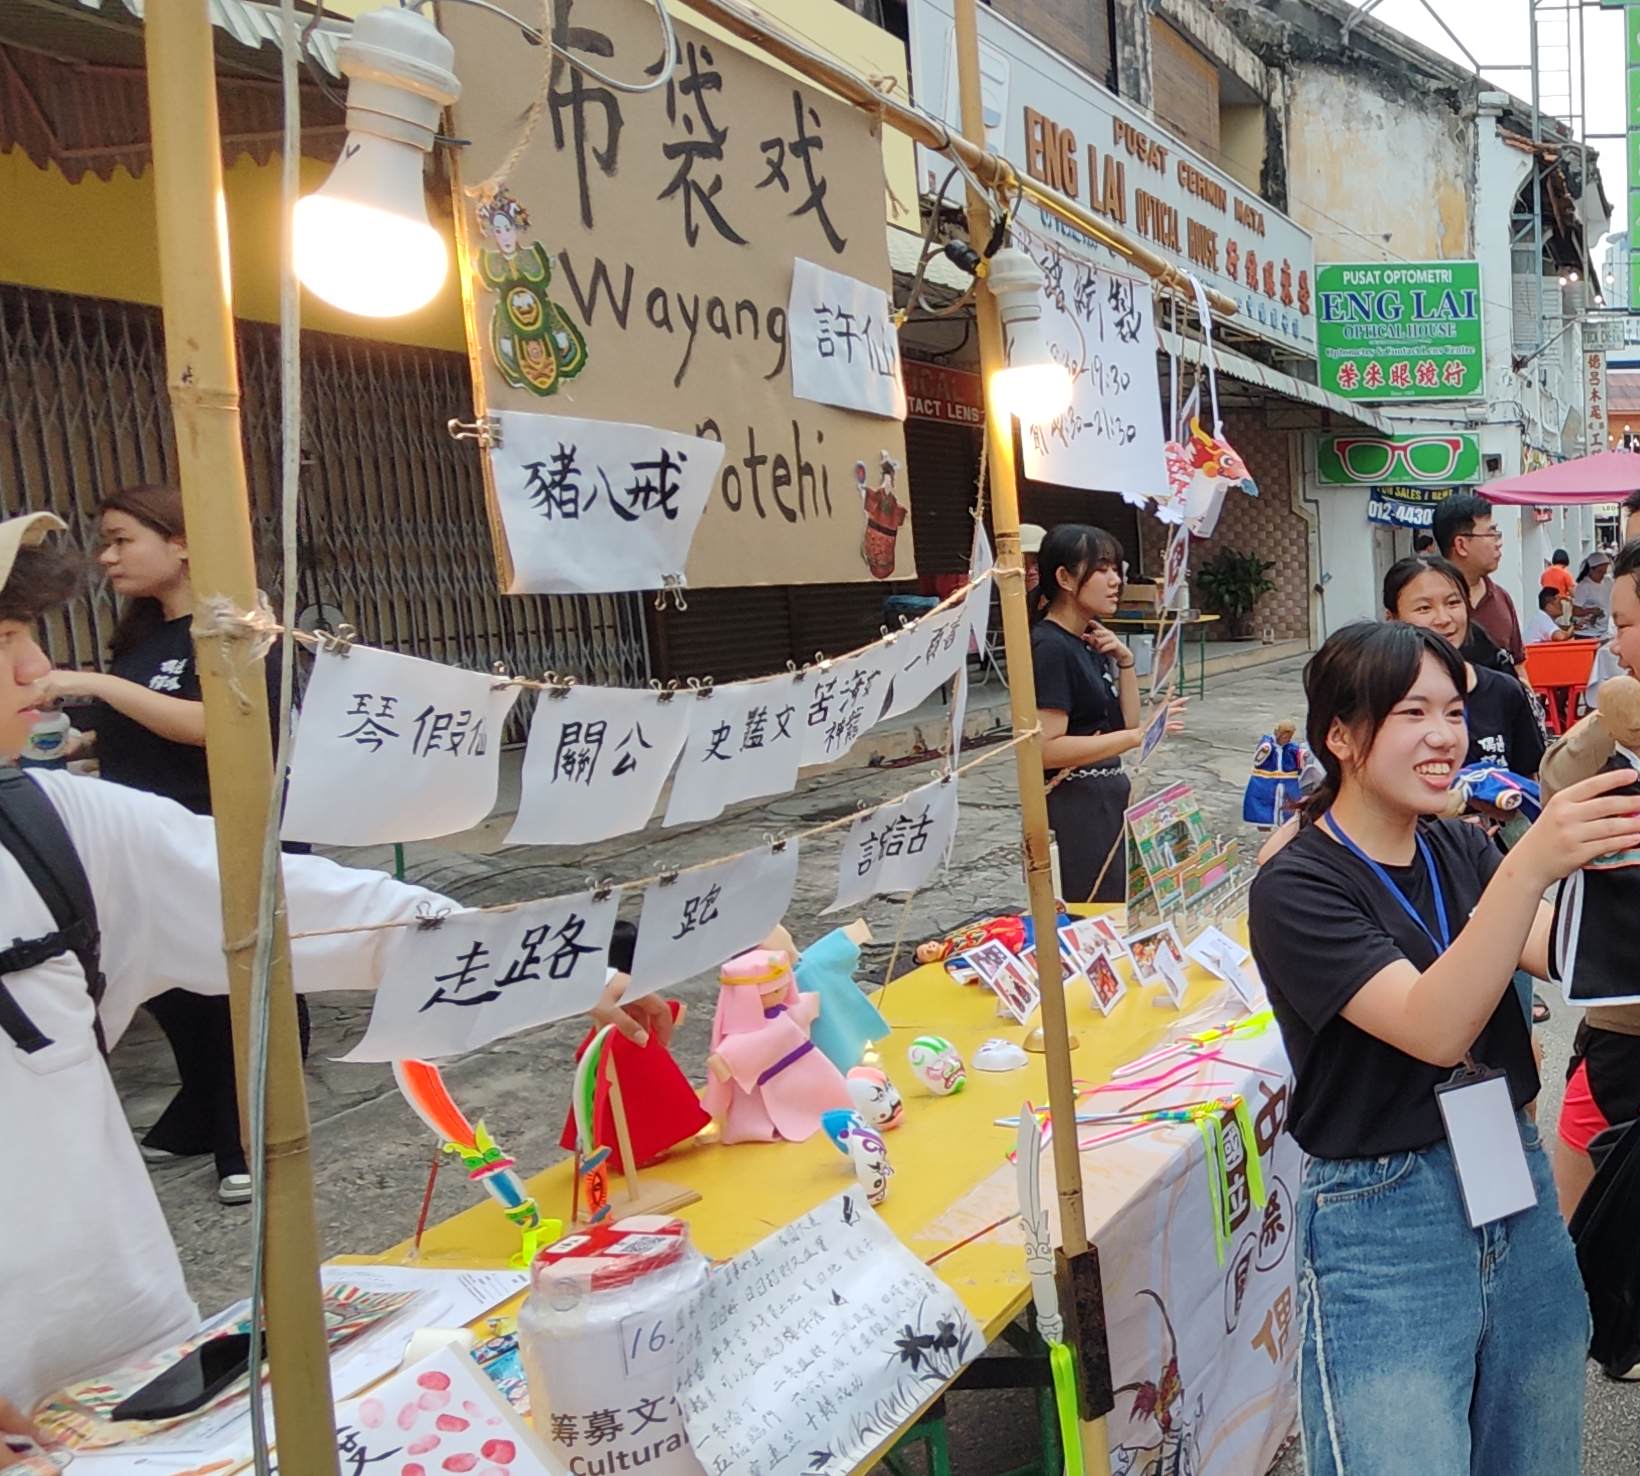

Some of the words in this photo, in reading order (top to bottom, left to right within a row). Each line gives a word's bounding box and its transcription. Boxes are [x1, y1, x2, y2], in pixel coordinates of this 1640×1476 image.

[520, 0, 848, 254] 布袋戏
[1024, 105, 1079, 199] ENG
[1087, 144, 1128, 224] LAI
[1135, 188, 1181, 254] OPTICAL
[1112, 115, 1170, 176] PUSAT
[1177, 159, 1227, 214] CERMIN
[1234, 196, 1265, 238] MATA
[1343, 270, 1381, 285] PUSAT
[1383, 269, 1452, 285] OPTOMETRI
[558, 248, 790, 389] Wayang
[1320, 290, 1403, 322] ENG
[1410, 289, 1477, 321] LAI
[1343, 324, 1406, 339] OPTICAL
[1408, 322, 1457, 338] HOUSE
[1337, 359, 1467, 391] 榮來眼鏡行
[907, 396, 941, 416] TACT
[947, 402, 985, 421] LENS
[523, 443, 688, 522] 豬八戒
[1395, 487, 1422, 500] SALES
[1368, 500, 1435, 525] 012-4430
[551, 719, 653, 787] 關公
[674, 883, 723, 940] 跑
[418, 914, 603, 1012] 走路
[551, 1395, 683, 1448] 筹募文
